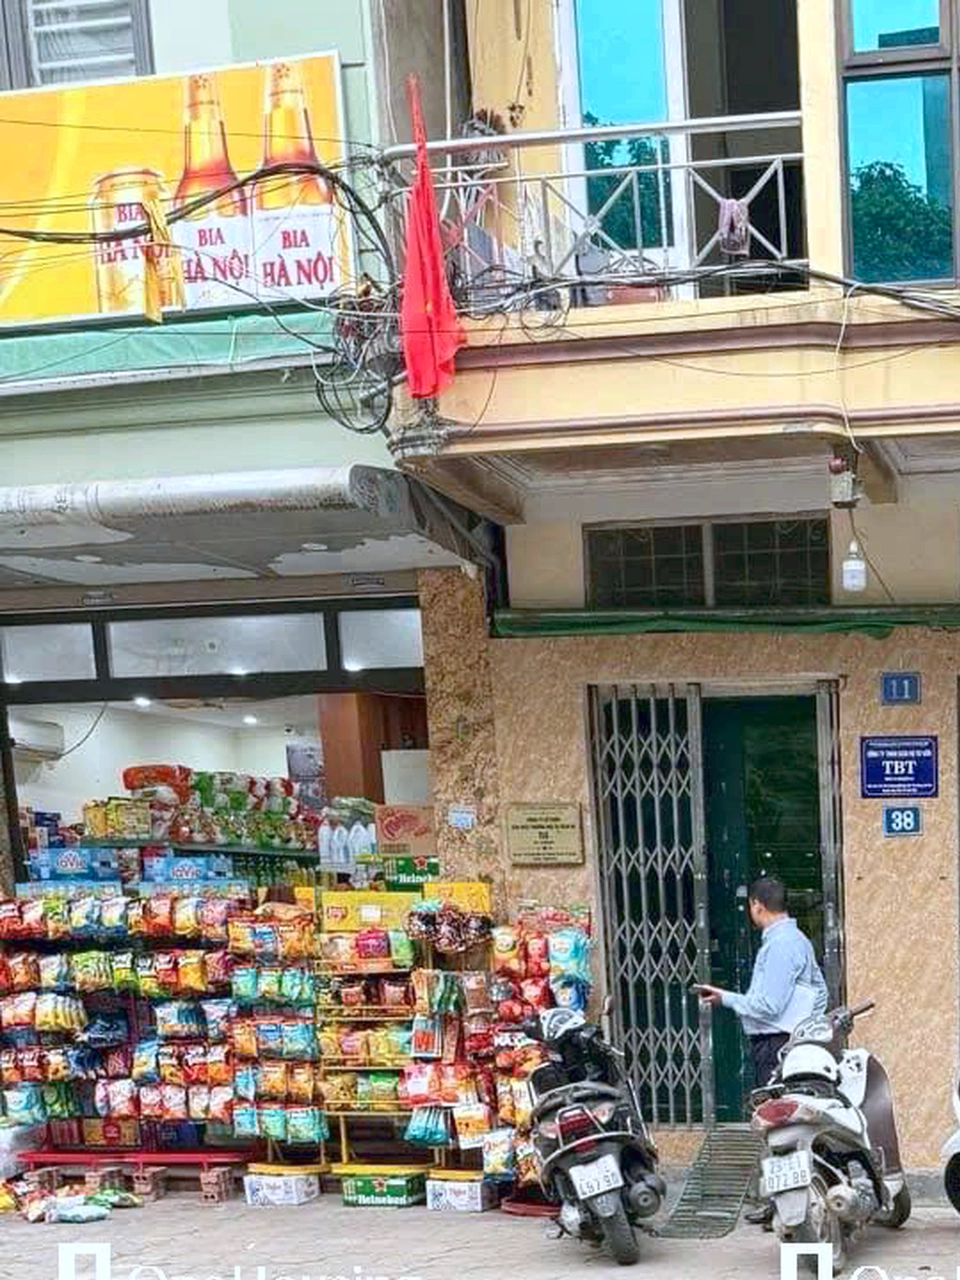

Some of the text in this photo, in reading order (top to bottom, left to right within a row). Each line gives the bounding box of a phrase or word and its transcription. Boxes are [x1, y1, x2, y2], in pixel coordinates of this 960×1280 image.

[197, 227, 225, 246] BIA
[281, 229, 310, 249] BIA
[263, 251, 334, 290] HÀ NỘI
[891, 679, 912, 699] 11
[882, 760, 917, 775] TBT
[891, 810, 914, 831] 38
